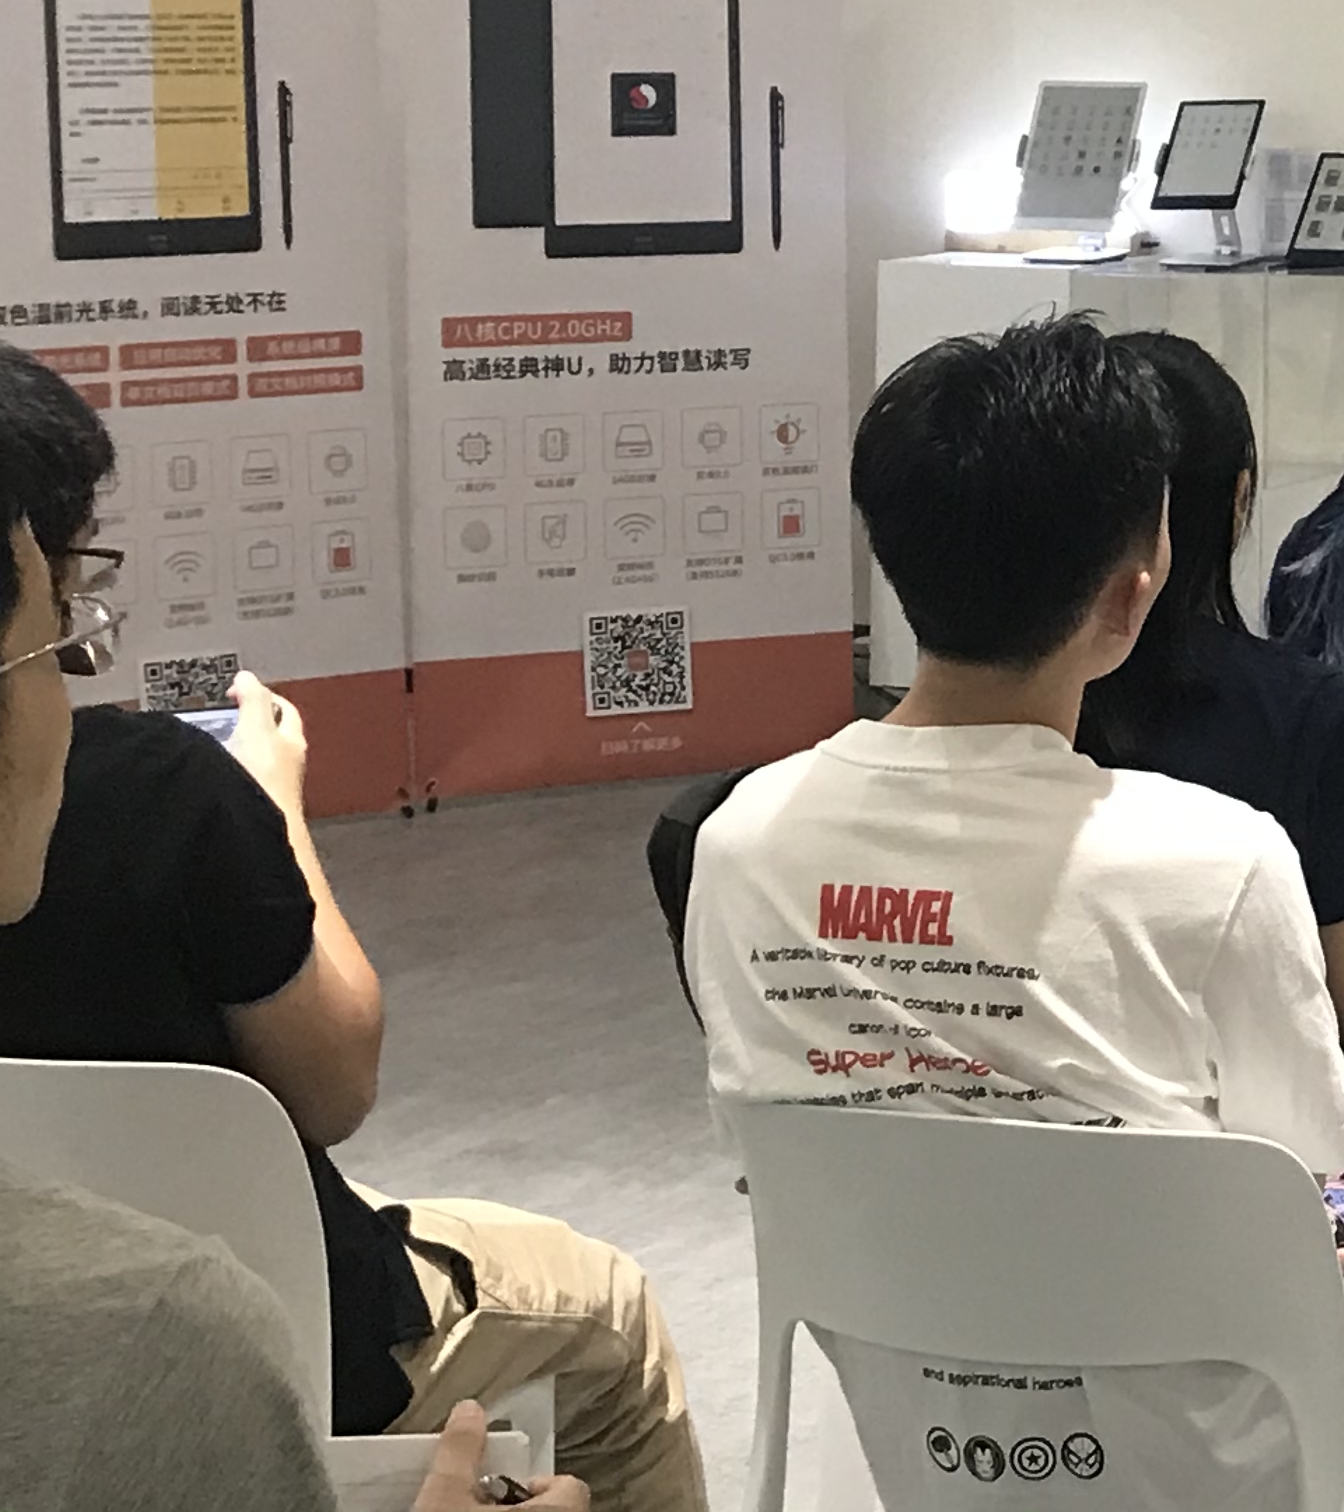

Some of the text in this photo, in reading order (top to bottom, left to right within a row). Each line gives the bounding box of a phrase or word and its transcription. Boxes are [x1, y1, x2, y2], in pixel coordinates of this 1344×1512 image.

[455, 317, 623, 343] 八核CPU 2.0GHz
[817, 882, 955, 947] MARVEL
[750, 948, 761, 963] A
[870, 954, 887, 968] of
[889, 958, 917, 974] pop
[764, 987, 789, 1002] the
[970, 1002, 981, 1016] a
[986, 1001, 1024, 1020] large
[806, 1048, 896, 1078] Super
[922, 1367, 945, 1382] and
